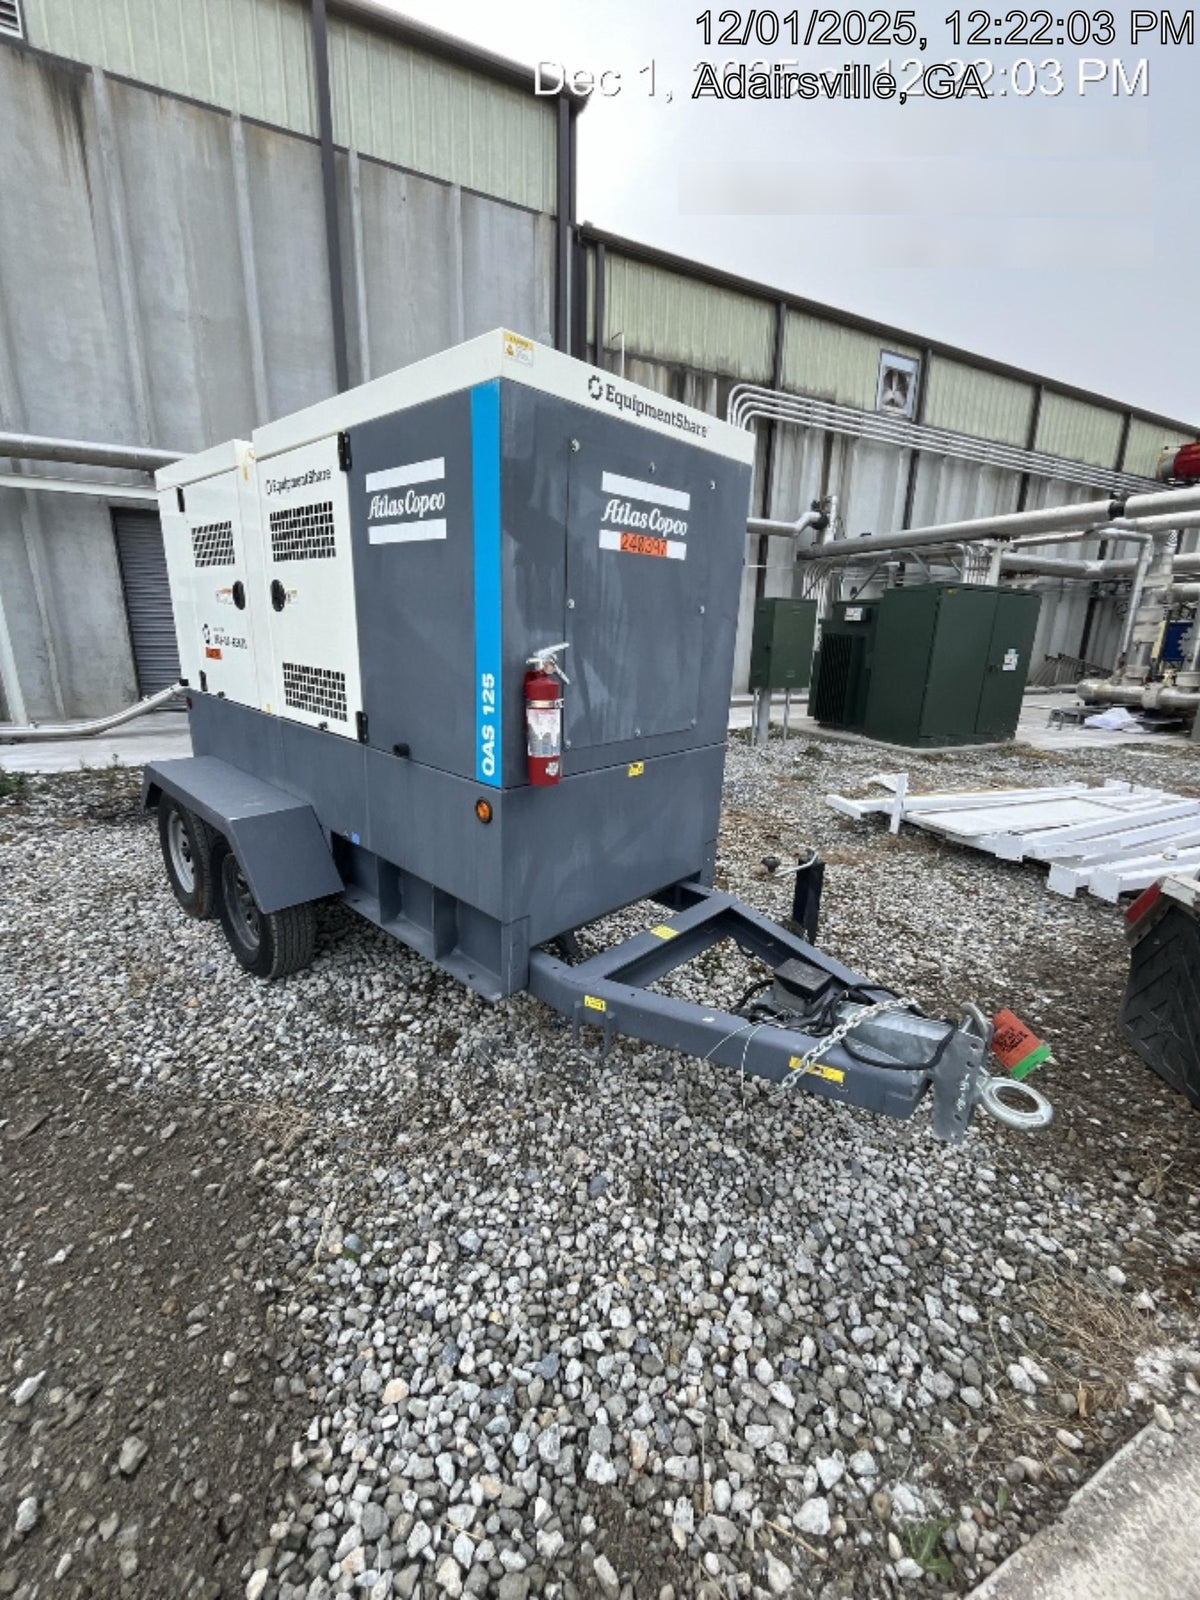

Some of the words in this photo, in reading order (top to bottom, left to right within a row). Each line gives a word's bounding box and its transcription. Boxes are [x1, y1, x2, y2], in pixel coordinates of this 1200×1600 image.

[606, 383, 709, 438] EquipmentShare
[368, 493, 404, 520] Atlas
[404, 489, 446, 518] Copco
[601, 499, 649, 529] Atlas
[649, 508, 688, 537] Copco
[481, 672, 496, 716] 125
